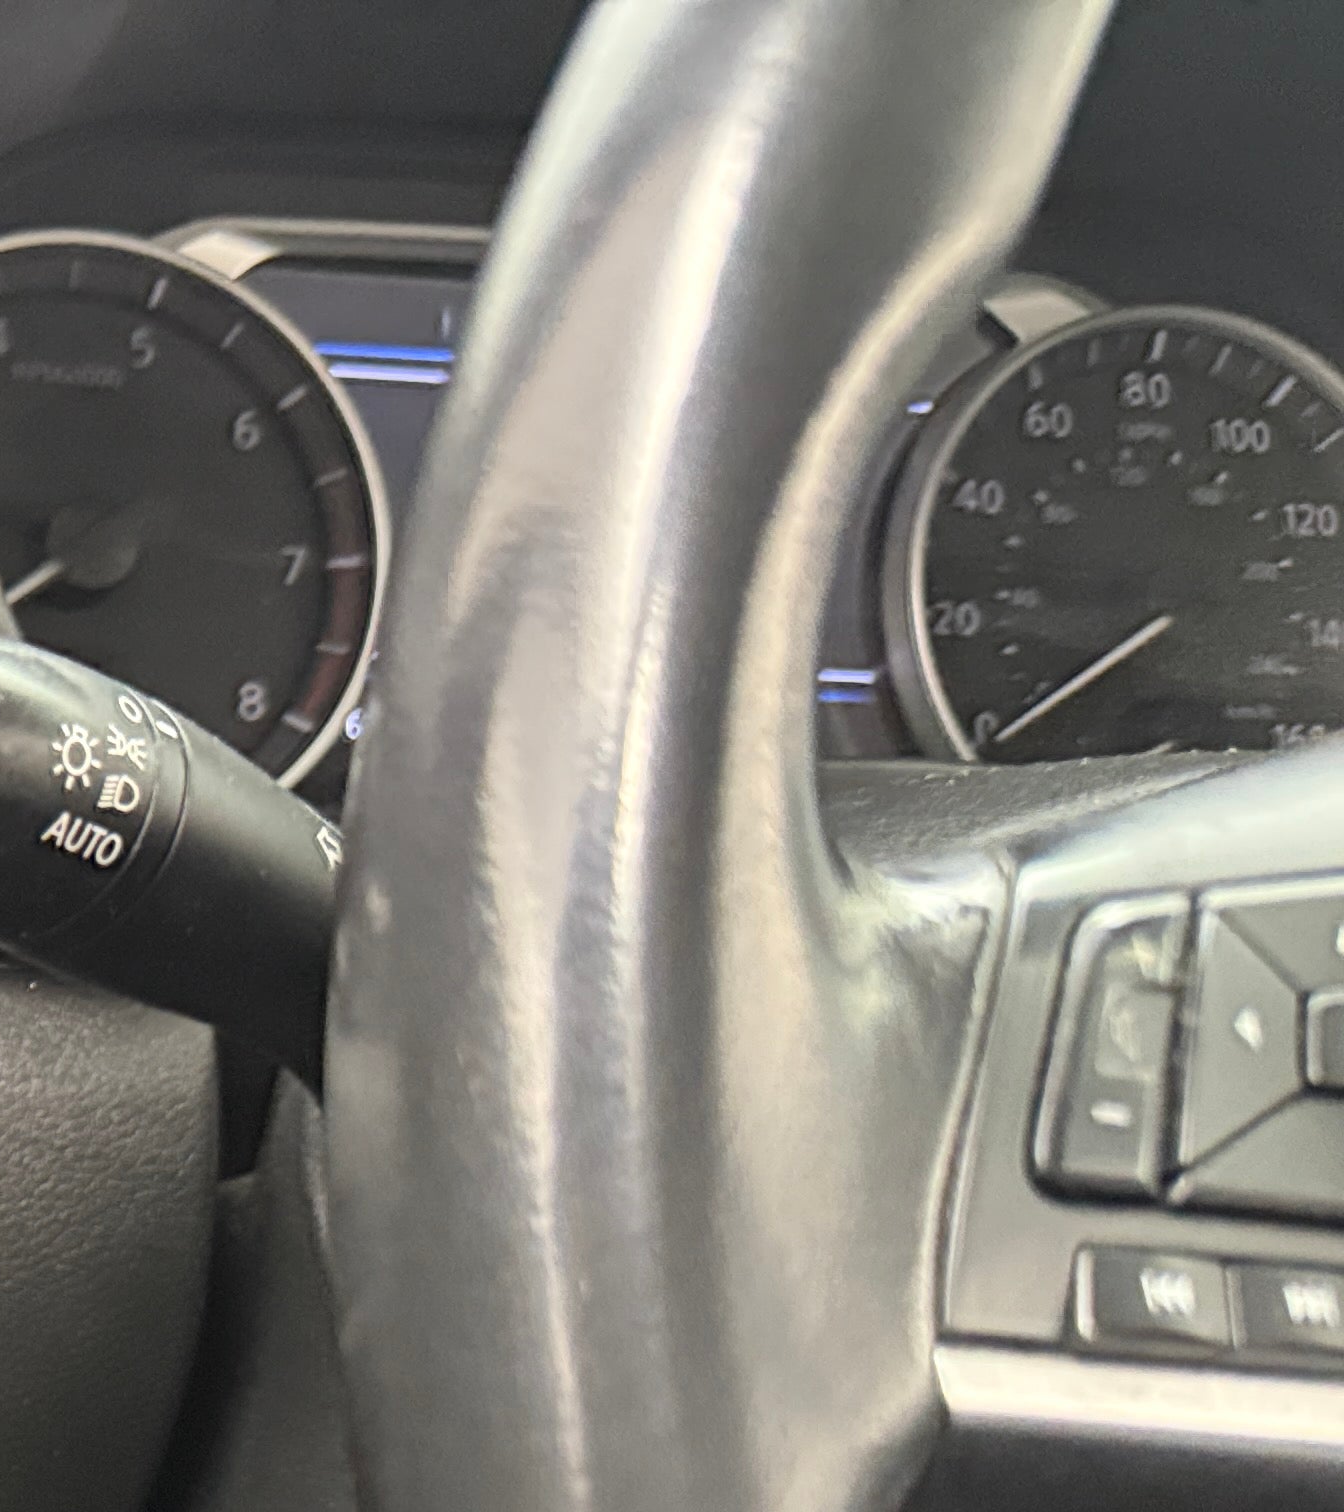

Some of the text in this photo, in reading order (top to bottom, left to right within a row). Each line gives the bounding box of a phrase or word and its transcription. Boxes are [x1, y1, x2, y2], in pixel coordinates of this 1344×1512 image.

[129, 328, 157, 368] 5
[232, 410, 262, 450] 6
[1024, 402, 1073, 438] 60
[1214, 420, 1270, 454] 100
[954, 480, 1004, 515] 40
[1282, 503, 1338, 537] 120
[281, 545, 307, 586] 7
[931, 602, 981, 637] 20
[1312, 618, 1344, 650] 14
[237, 680, 267, 722] 8
[39, 811, 124, 868] AUTO
